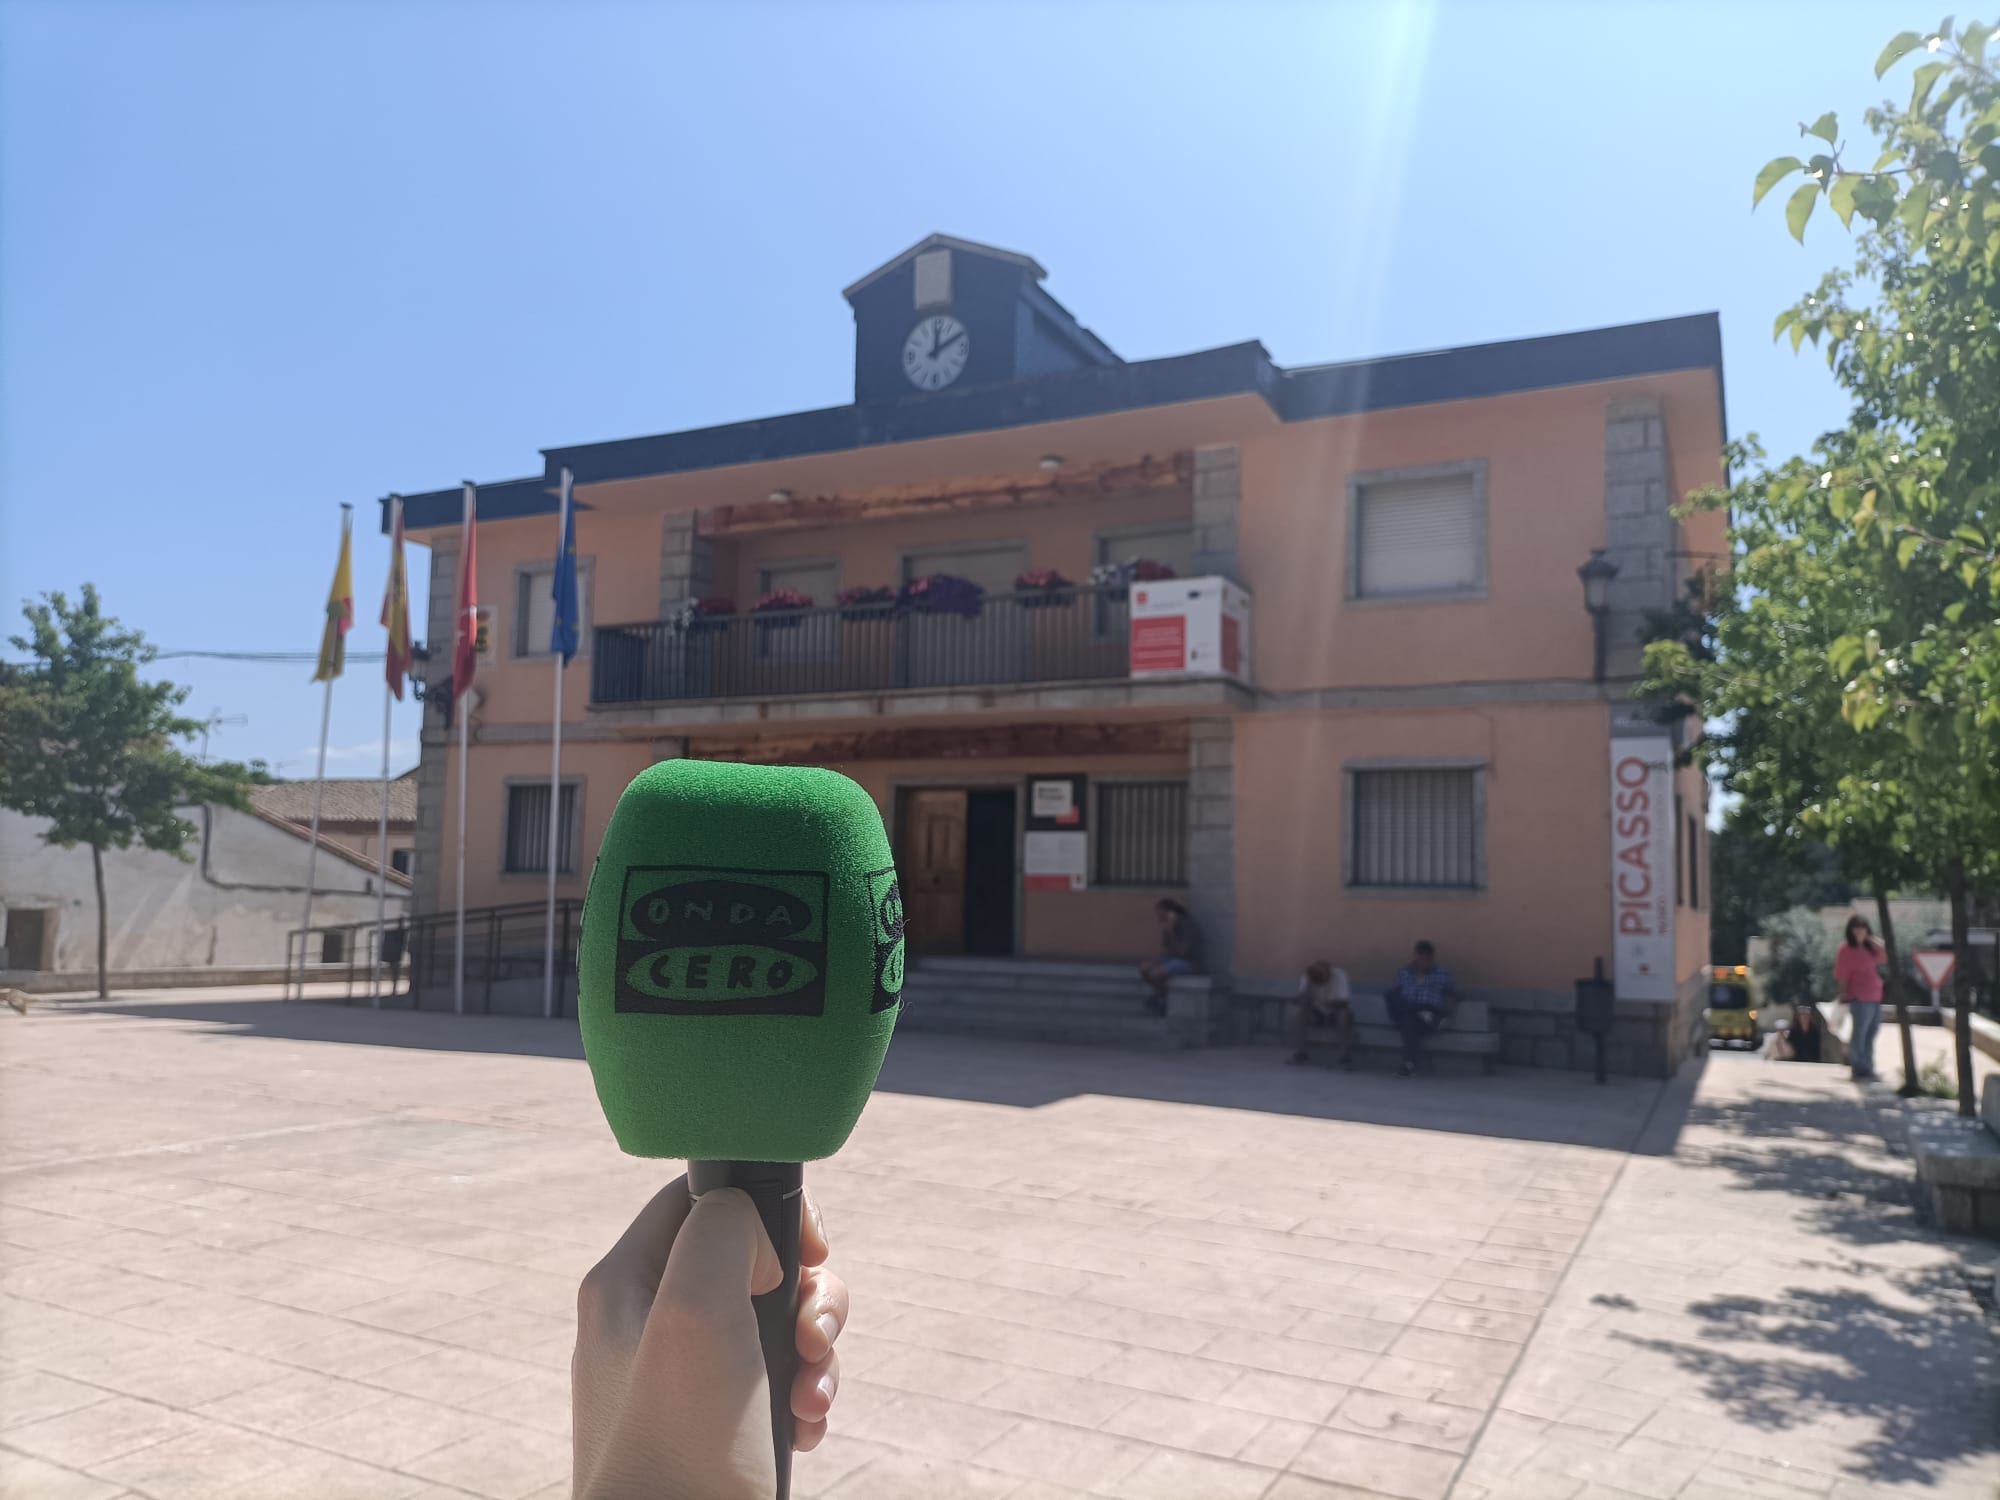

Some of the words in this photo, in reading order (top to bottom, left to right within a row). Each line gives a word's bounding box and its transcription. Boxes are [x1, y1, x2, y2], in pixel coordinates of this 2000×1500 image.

[1616, 757, 1651, 935] PICASSO
[648, 898, 793, 926] ONDA
[651, 956, 793, 989] CERO
